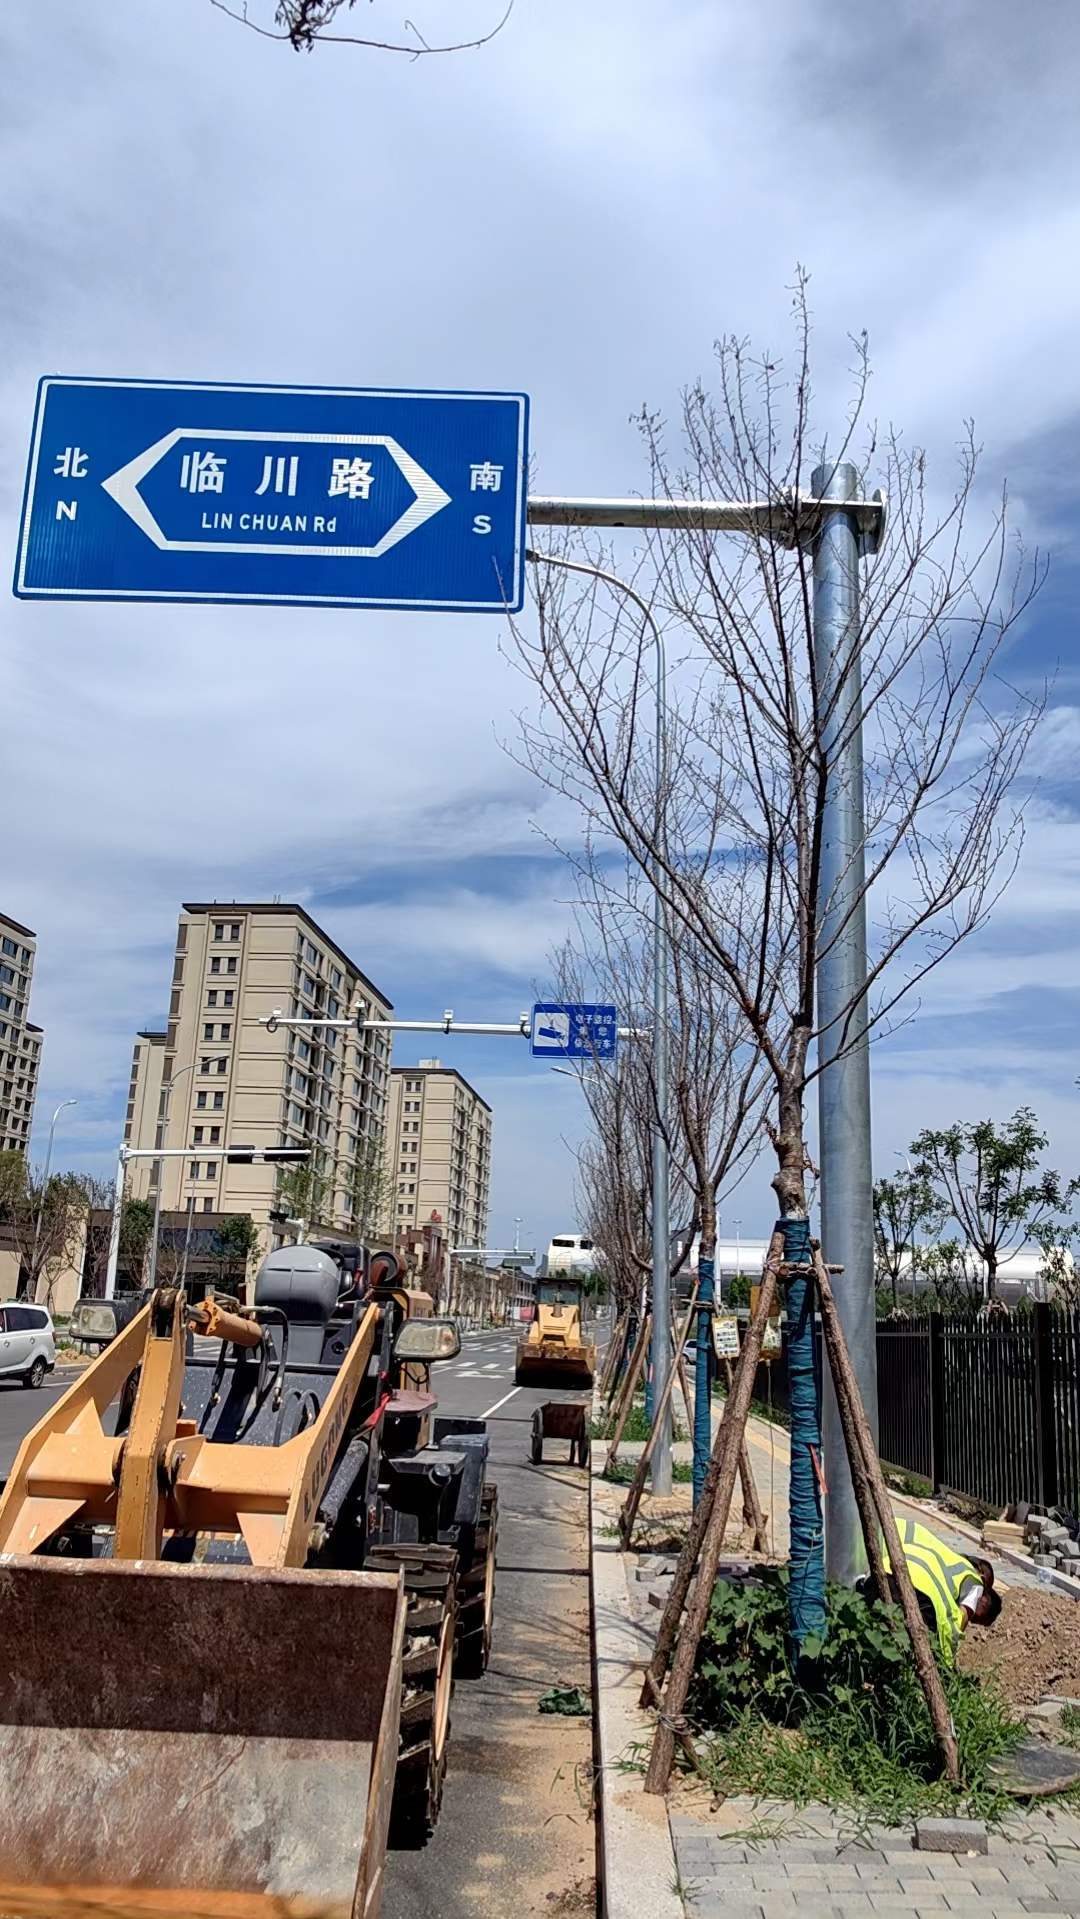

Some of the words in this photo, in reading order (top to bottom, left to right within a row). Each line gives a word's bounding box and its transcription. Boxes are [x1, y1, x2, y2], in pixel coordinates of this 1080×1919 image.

[54, 448, 88, 477] 北
[180, 451, 375, 500] 临川路
[470, 462, 504, 491] 南
[56, 501, 77, 520] N
[201, 512, 233, 529] LIN
[239, 513, 307, 532] CHUAN
[313, 516, 337, 533] Rd
[473, 514, 492, 534] S
